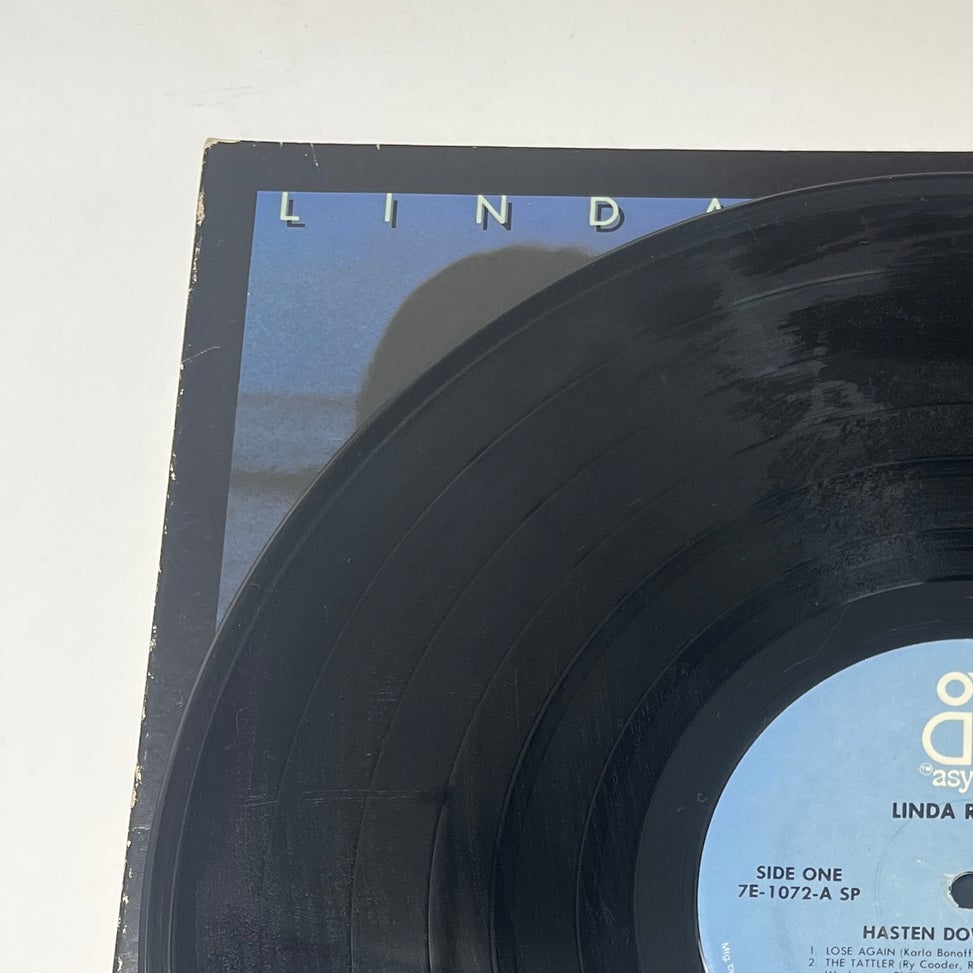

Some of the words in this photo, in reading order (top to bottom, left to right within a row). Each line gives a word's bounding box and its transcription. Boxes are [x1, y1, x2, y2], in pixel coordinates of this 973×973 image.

[892, 802, 955, 819] LINDA
[756, 865, 795, 880] SIDE
[802, 867, 842, 881] ONE
[738, 884, 832, 900] 7E-1072-A
[840, 887, 860, 900] SP
[863, 925, 935, 941] HASTEN
[826, 946, 853, 956] LOSE
[858, 947, 896, 957] AGAIN
[900, 948, 932, 958] (Karla
[826, 958, 845, 967] THE
[851, 959, 894, 968] TATTLER
[899, 960, 915, 971] (Ry
[920, 960, 963, 970] Cooder,
